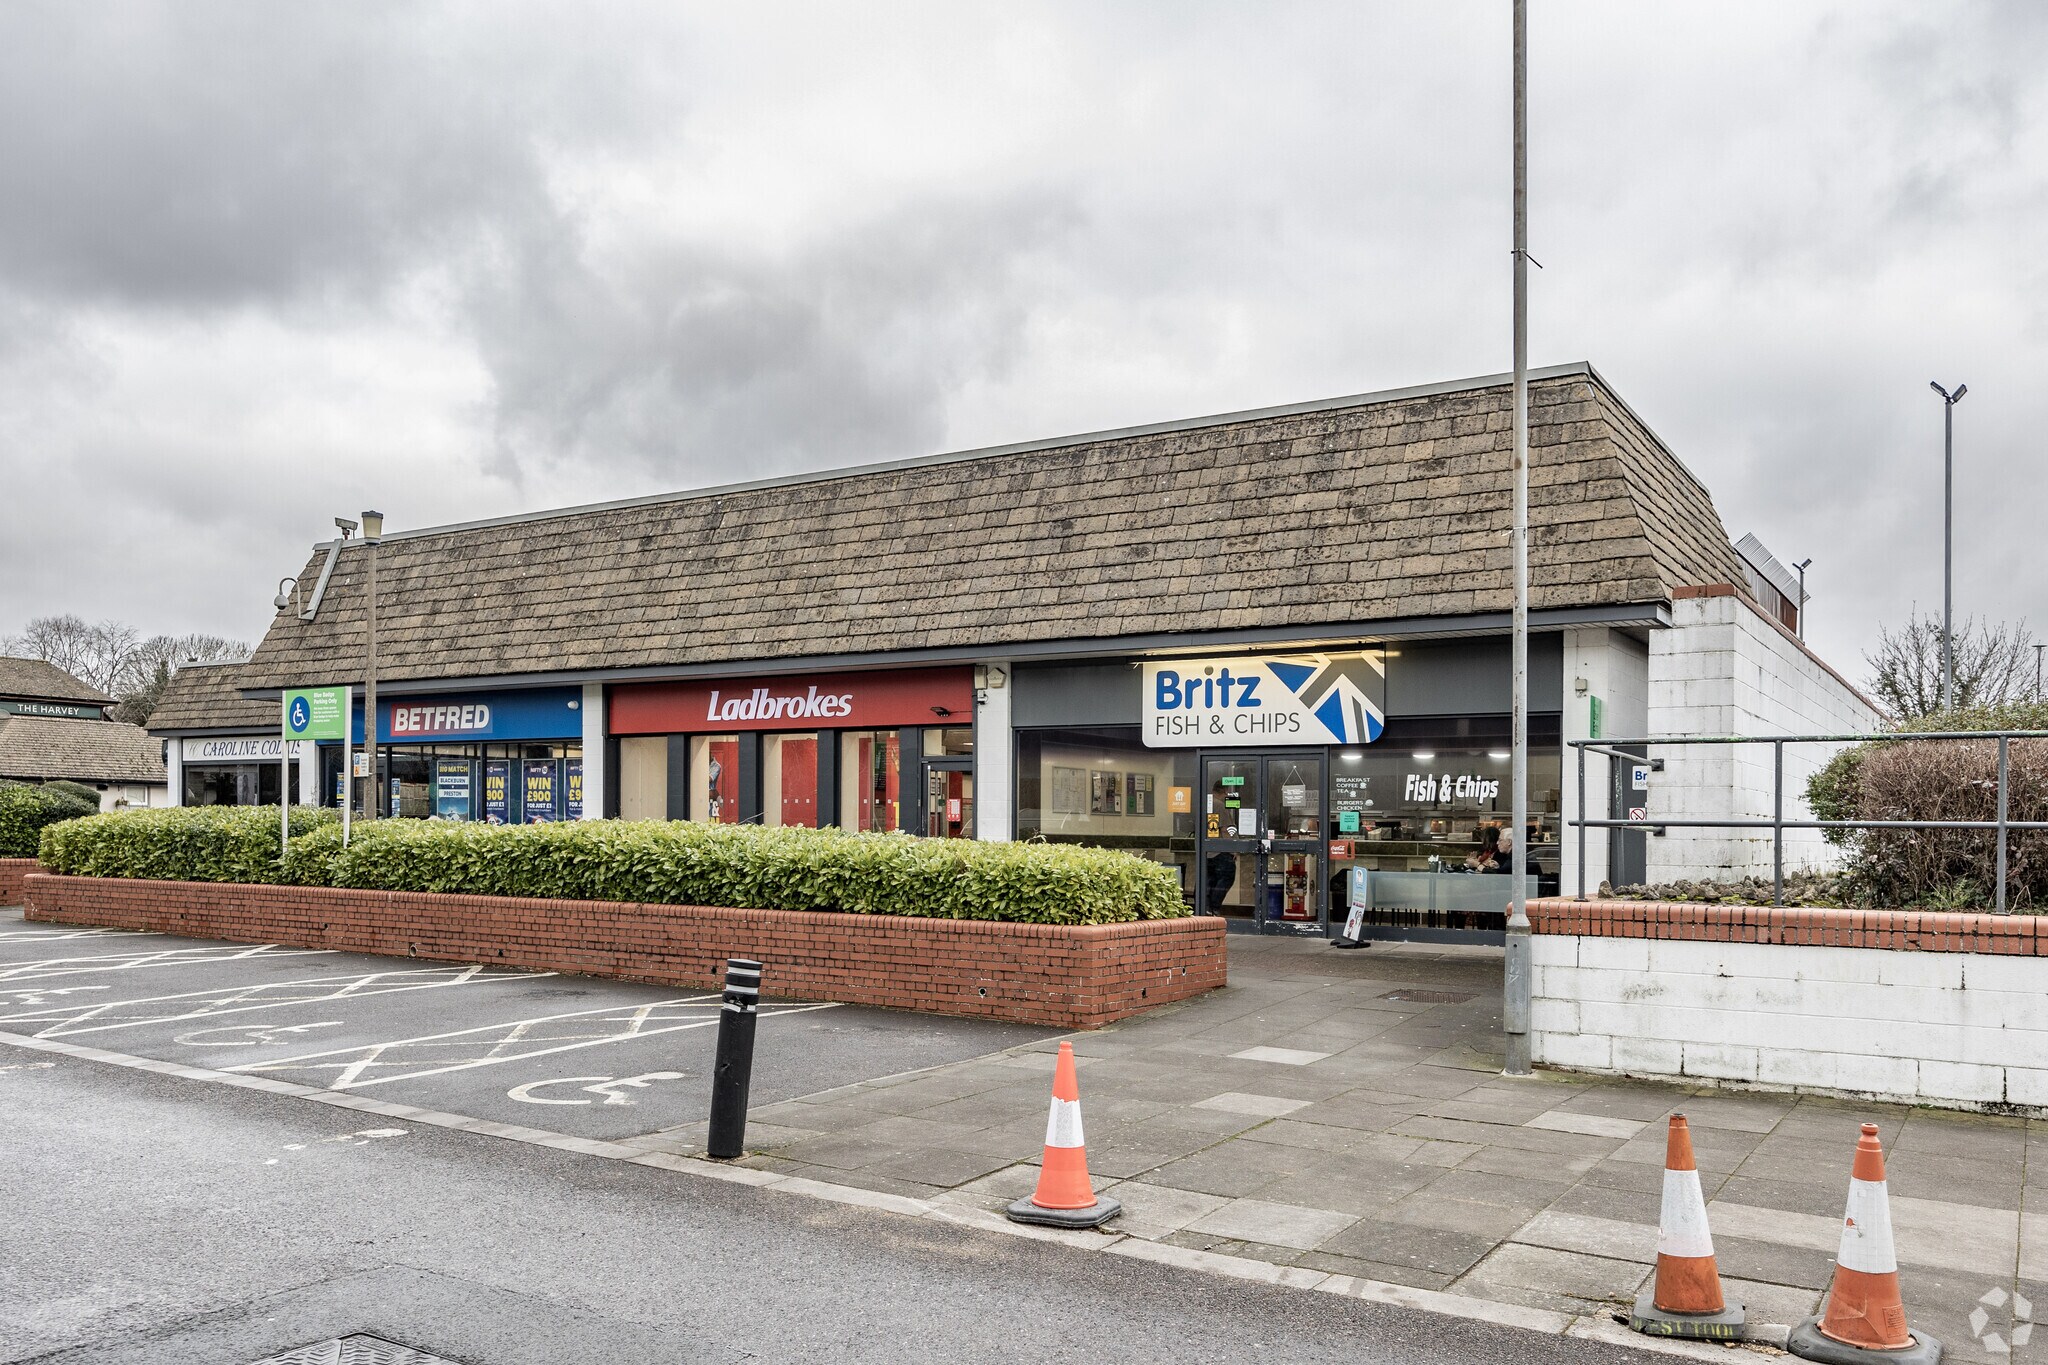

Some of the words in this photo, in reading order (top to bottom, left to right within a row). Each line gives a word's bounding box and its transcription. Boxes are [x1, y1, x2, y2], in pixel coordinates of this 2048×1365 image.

[1156, 665, 1262, 710] Britz
[17, 703, 38, 713] THE
[40, 705, 80, 716] HARVEY
[706, 685, 853, 722] Ladbrokes
[394, 704, 490, 732] BETFRED
[1156, 715, 1200, 736] FISH
[1209, 714, 1225, 735] &
[1234, 712, 1301, 734] CHIPS
[203, 740, 260, 757] CAROLINE
[261, 739, 301, 756] COLIS
[448, 765, 468, 773] MATCH
[527, 777, 552, 790] WIN
[1405, 773, 1437, 802] Fish
[1439, 773, 1452, 803] &
[1455, 774, 1500, 804] Chips
[526, 790, 552, 802] £900
